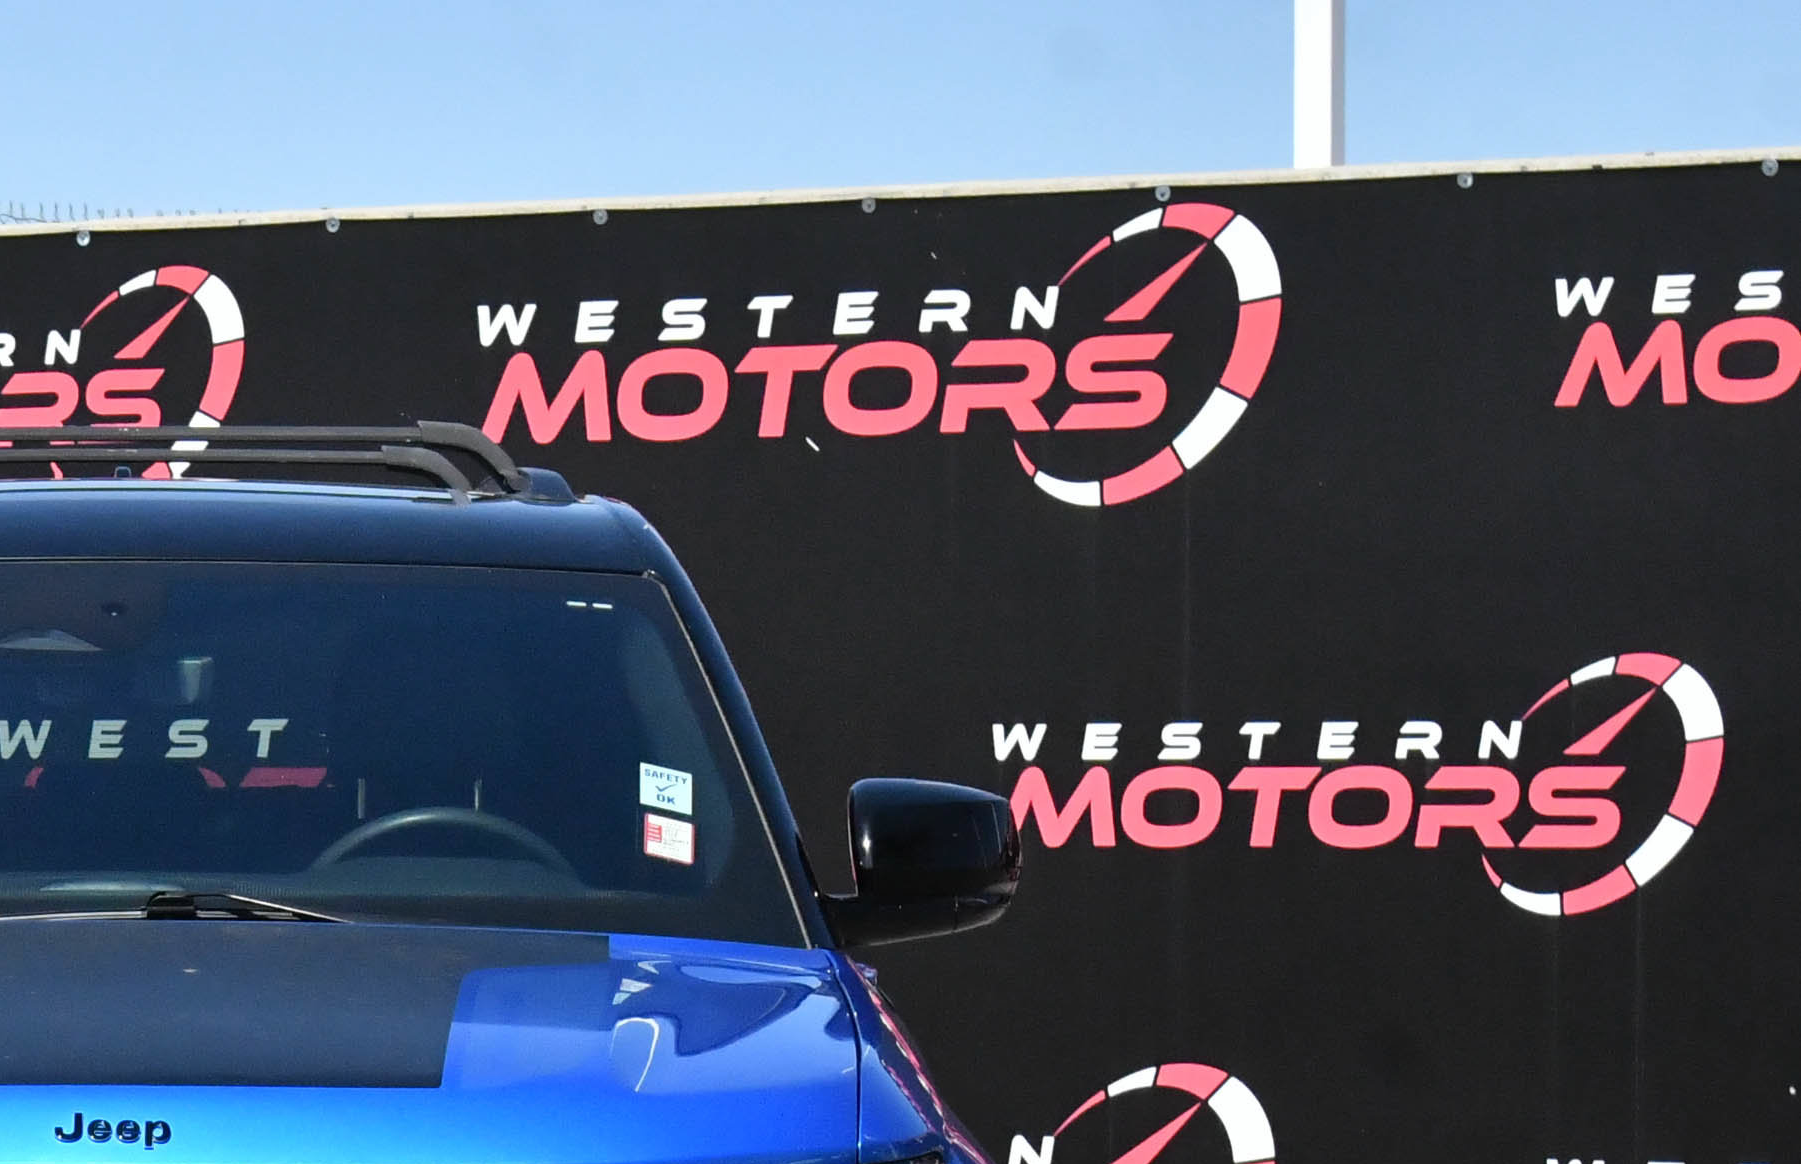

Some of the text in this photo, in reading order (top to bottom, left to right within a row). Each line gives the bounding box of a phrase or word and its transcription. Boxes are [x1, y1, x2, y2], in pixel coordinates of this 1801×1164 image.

[1555, 271, 1783, 317] WES
[477, 286, 1059, 347] WESTERN
[483, 333, 1173, 445] MOTORS
[992, 720, 1522, 761] WESTERN
[645, 769, 688, 785] SAFETY
[656, 793, 676, 805] OK
[1010, 765, 1627, 849] MOTORS
[54, 1112, 172, 1150] Jeep
